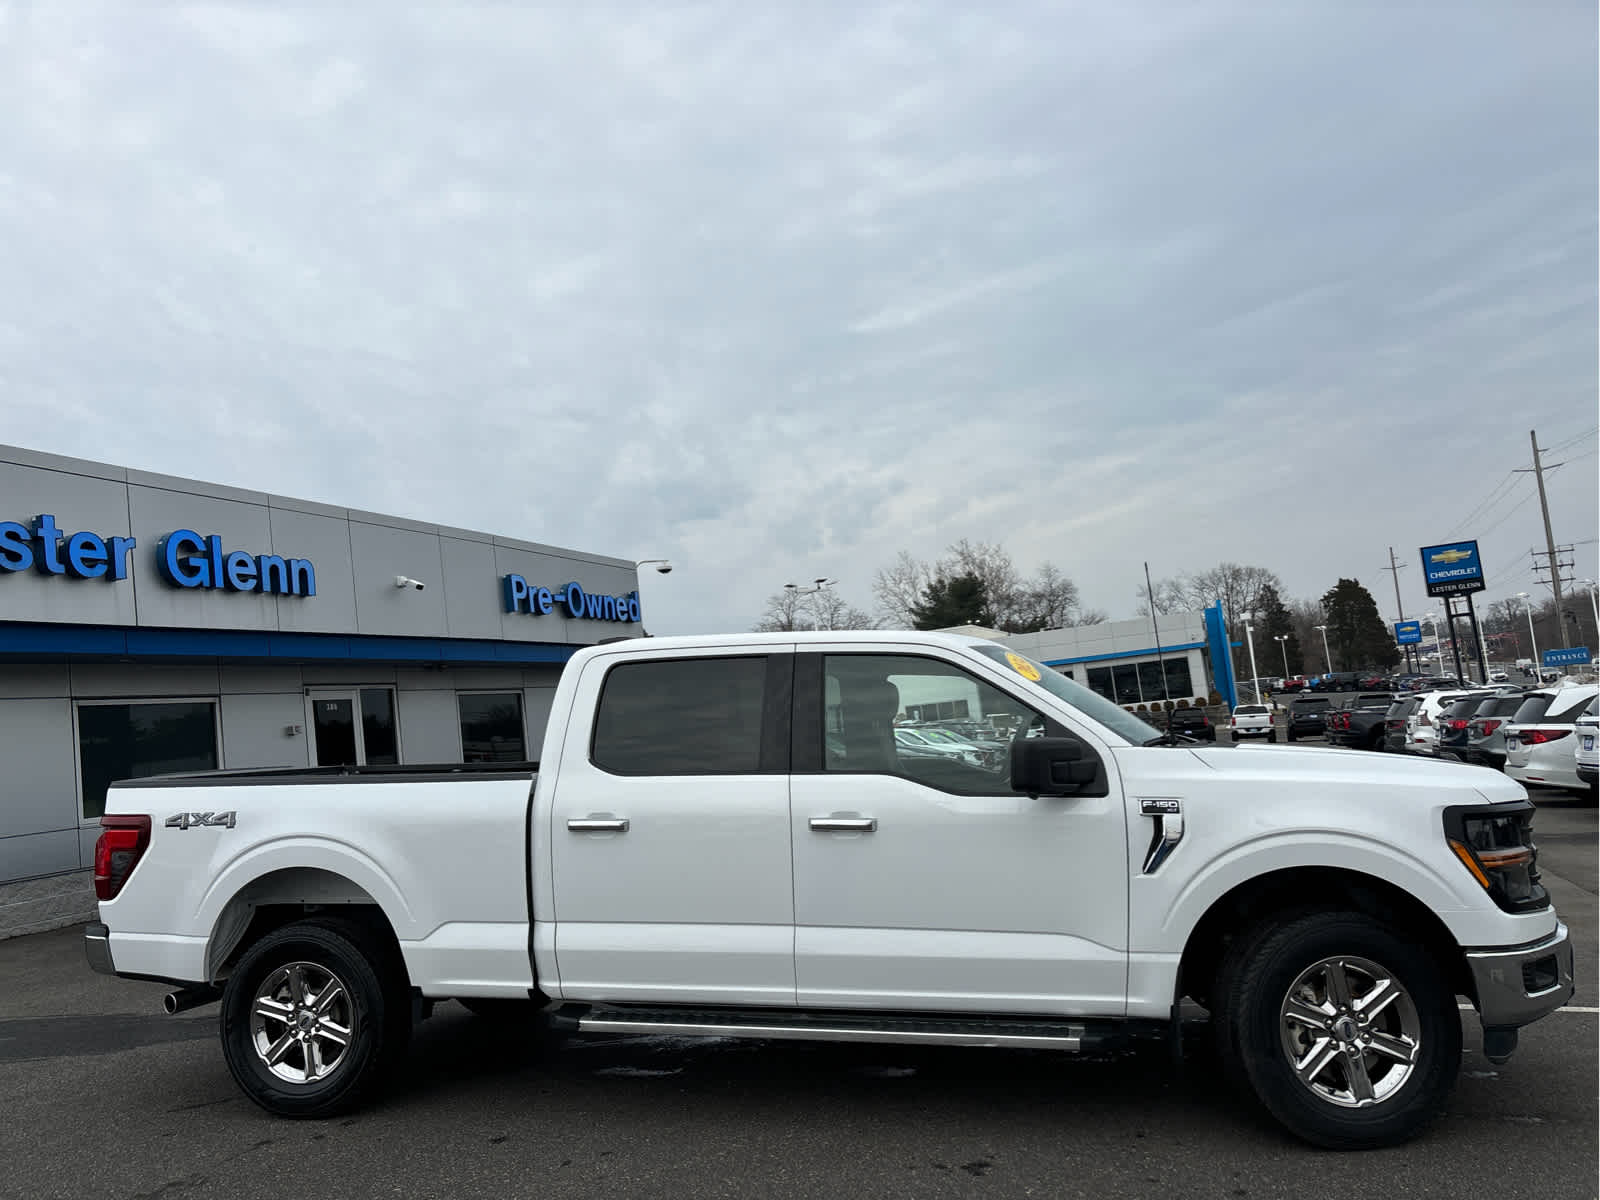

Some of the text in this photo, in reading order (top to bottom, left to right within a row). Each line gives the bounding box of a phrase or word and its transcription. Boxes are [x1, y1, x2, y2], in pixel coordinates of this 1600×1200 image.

[156, 529, 316, 597] Glenn
[1430, 567, 1477, 579] CHEVROLET
[1431, 581, 1481, 593] LESTER GLENN
[503, 574, 641, 622] Pre-Owned
[1546, 652, 1588, 662] ENTRANCE
